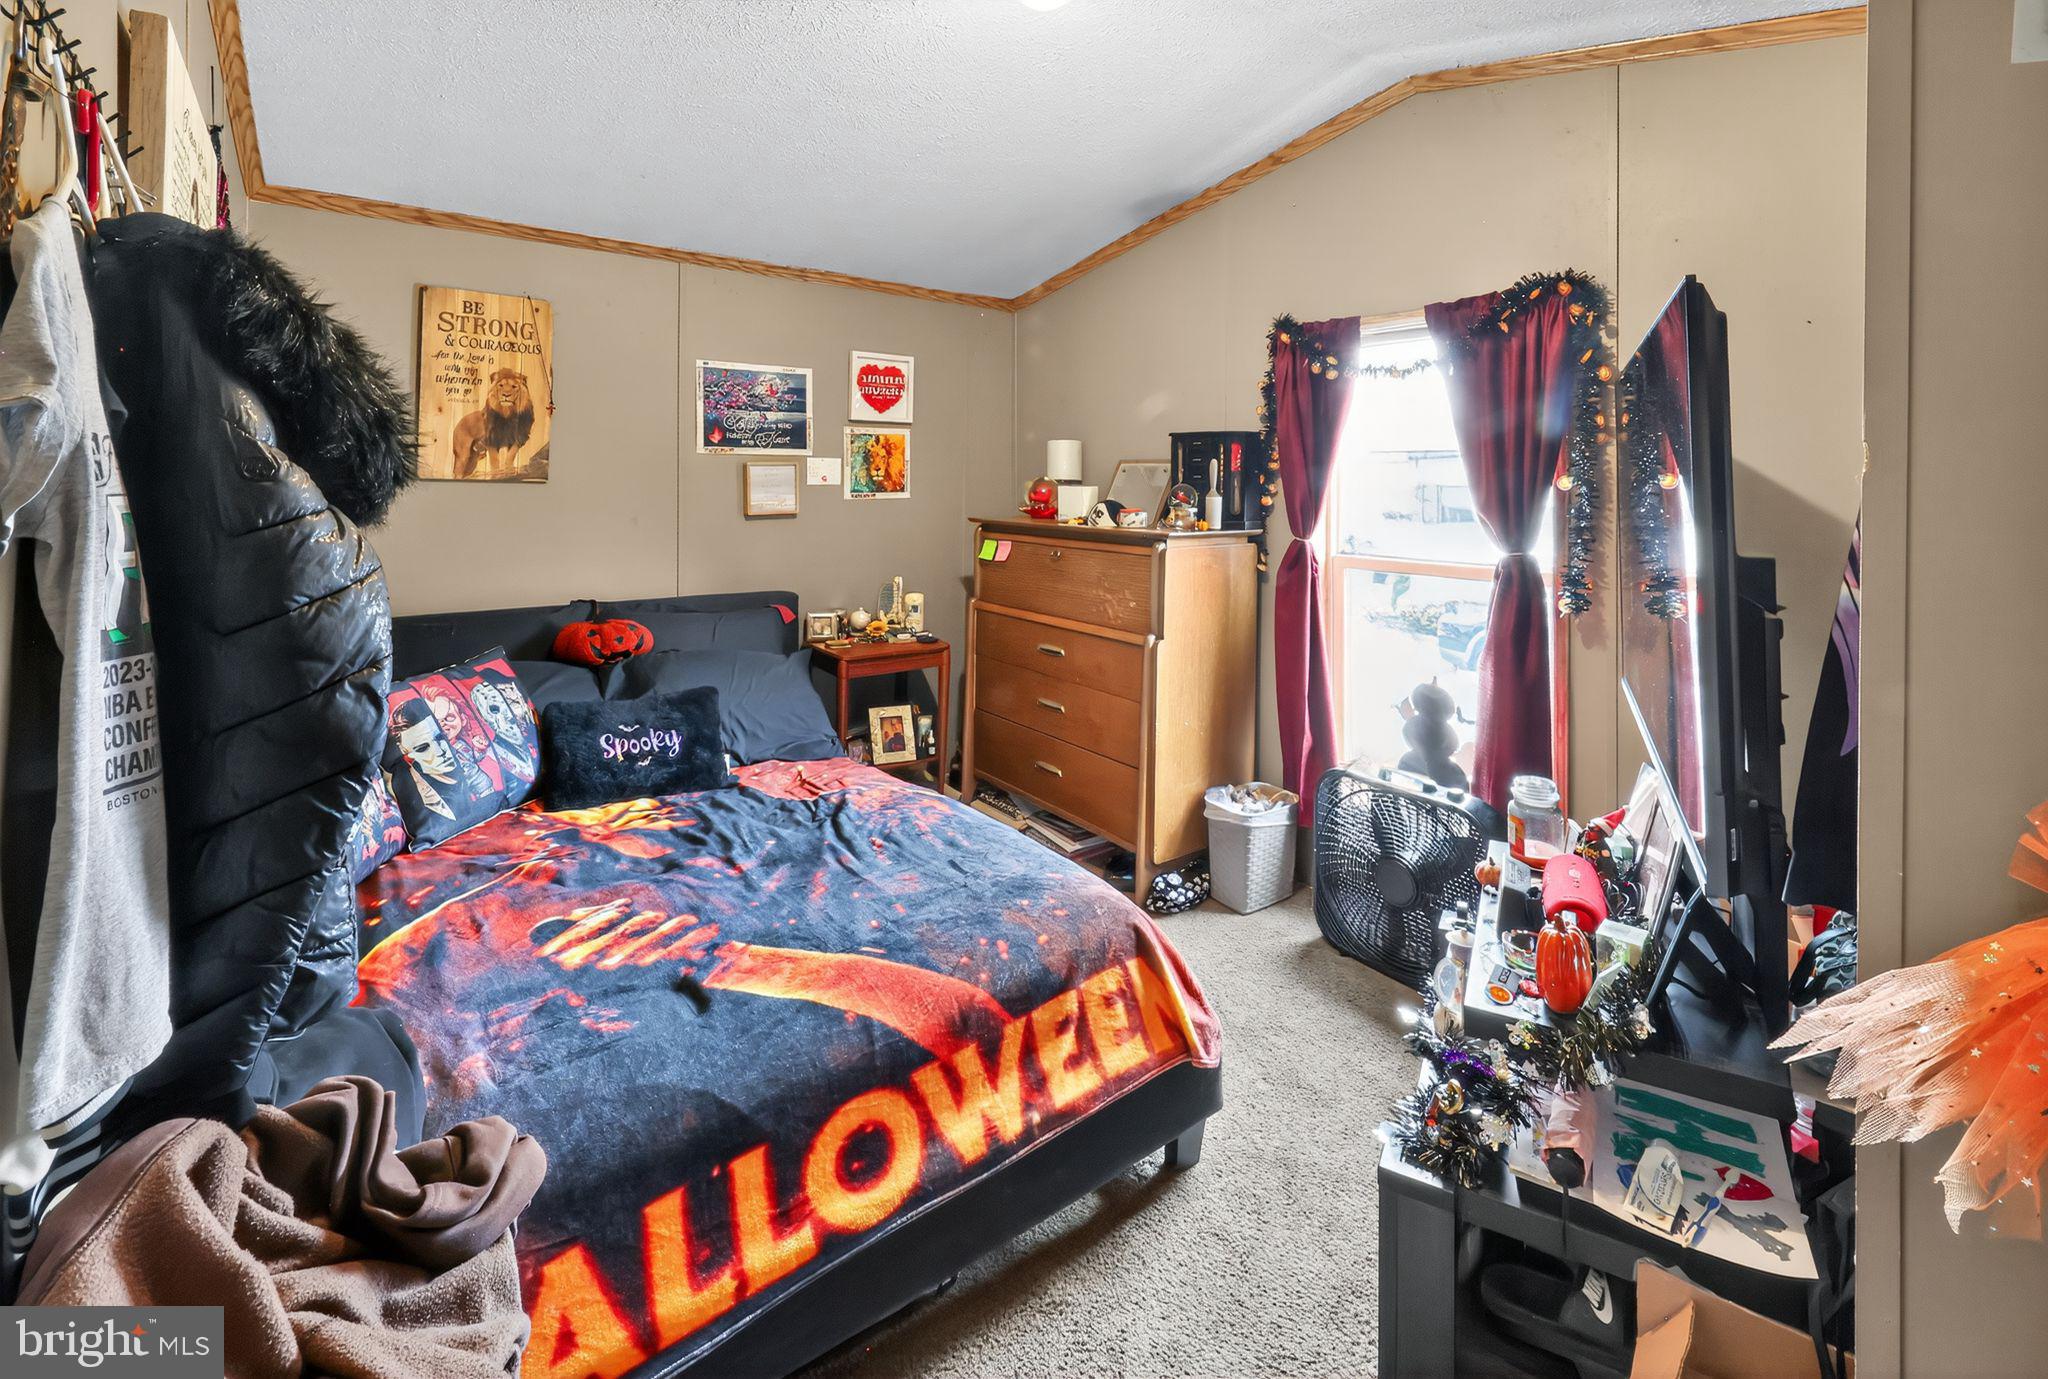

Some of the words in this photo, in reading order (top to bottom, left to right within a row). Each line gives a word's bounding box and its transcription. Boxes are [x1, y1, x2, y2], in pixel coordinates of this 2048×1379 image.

[462, 300, 485, 316] BE
[437, 311, 536, 340] STRONG
[444, 333, 455, 347] &
[458, 336, 542, 355] COURAGEOUS
[103, 657, 155, 689] 2023-
[104, 690, 143, 720] NBA
[600, 728, 682, 763] Spooky
[107, 786, 158, 811] BOSTON
